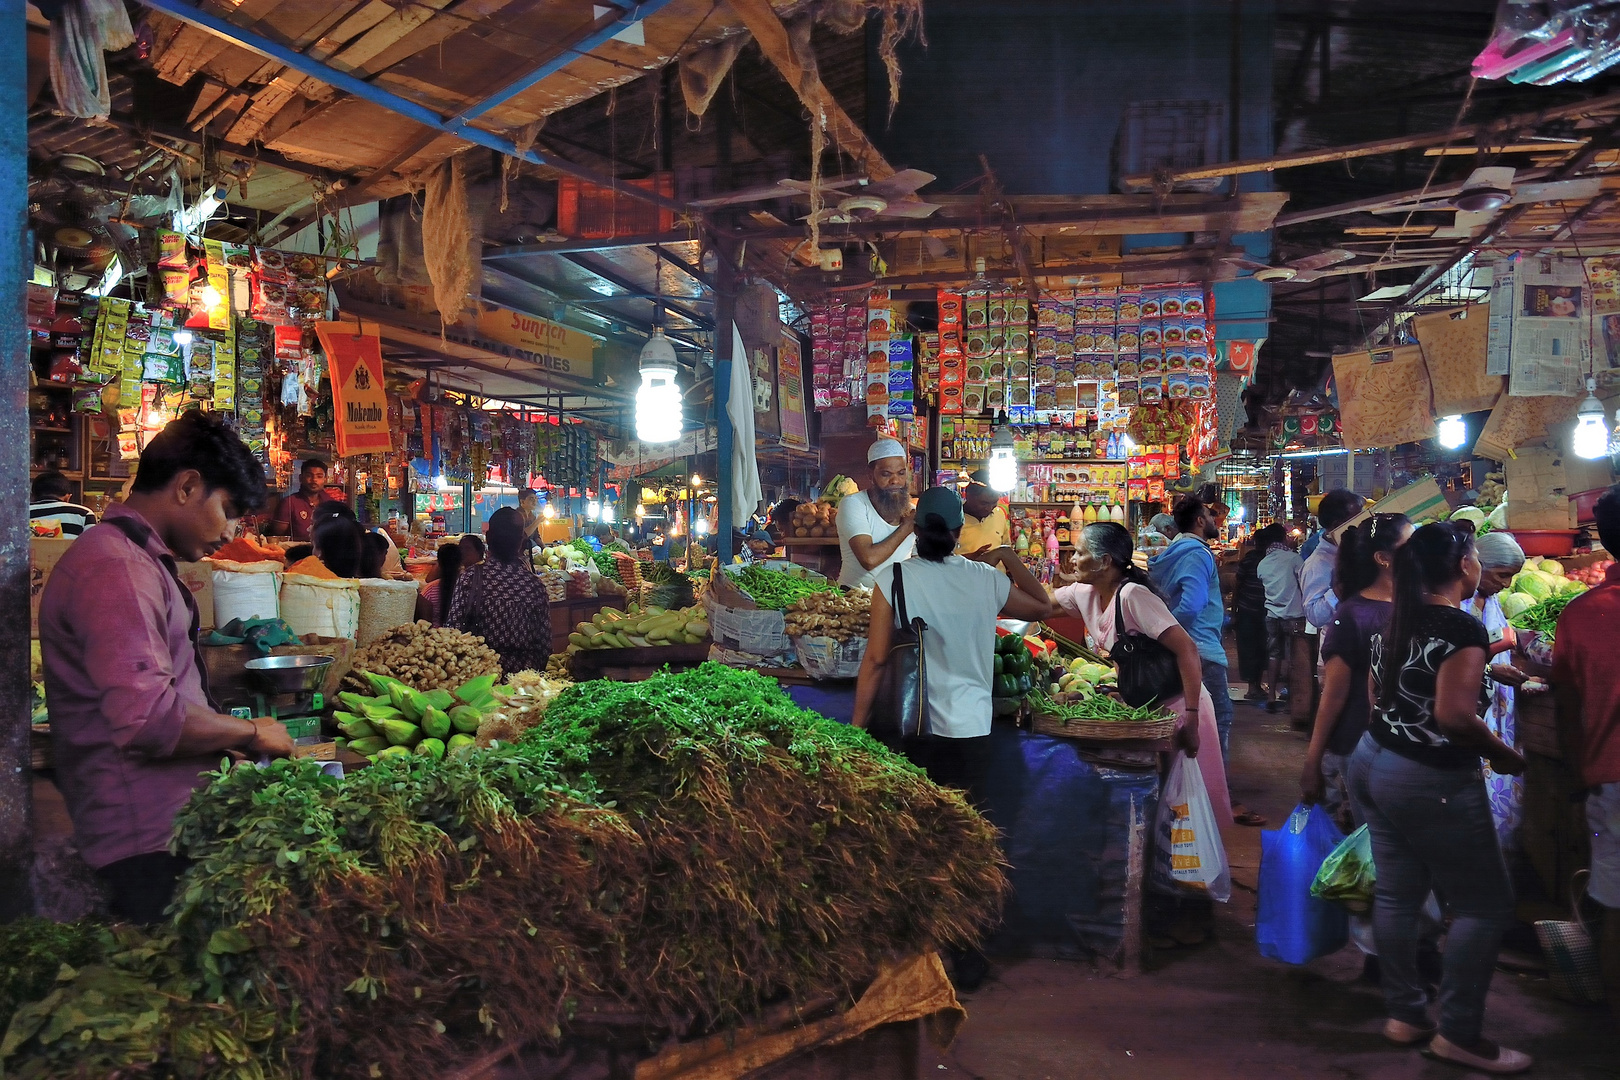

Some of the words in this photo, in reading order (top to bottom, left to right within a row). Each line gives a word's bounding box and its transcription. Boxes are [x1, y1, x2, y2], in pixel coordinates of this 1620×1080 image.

[511, 312, 567, 345] Sunrich
[515, 349, 570, 372] STORES
[346, 402, 382, 422] Mokembo
